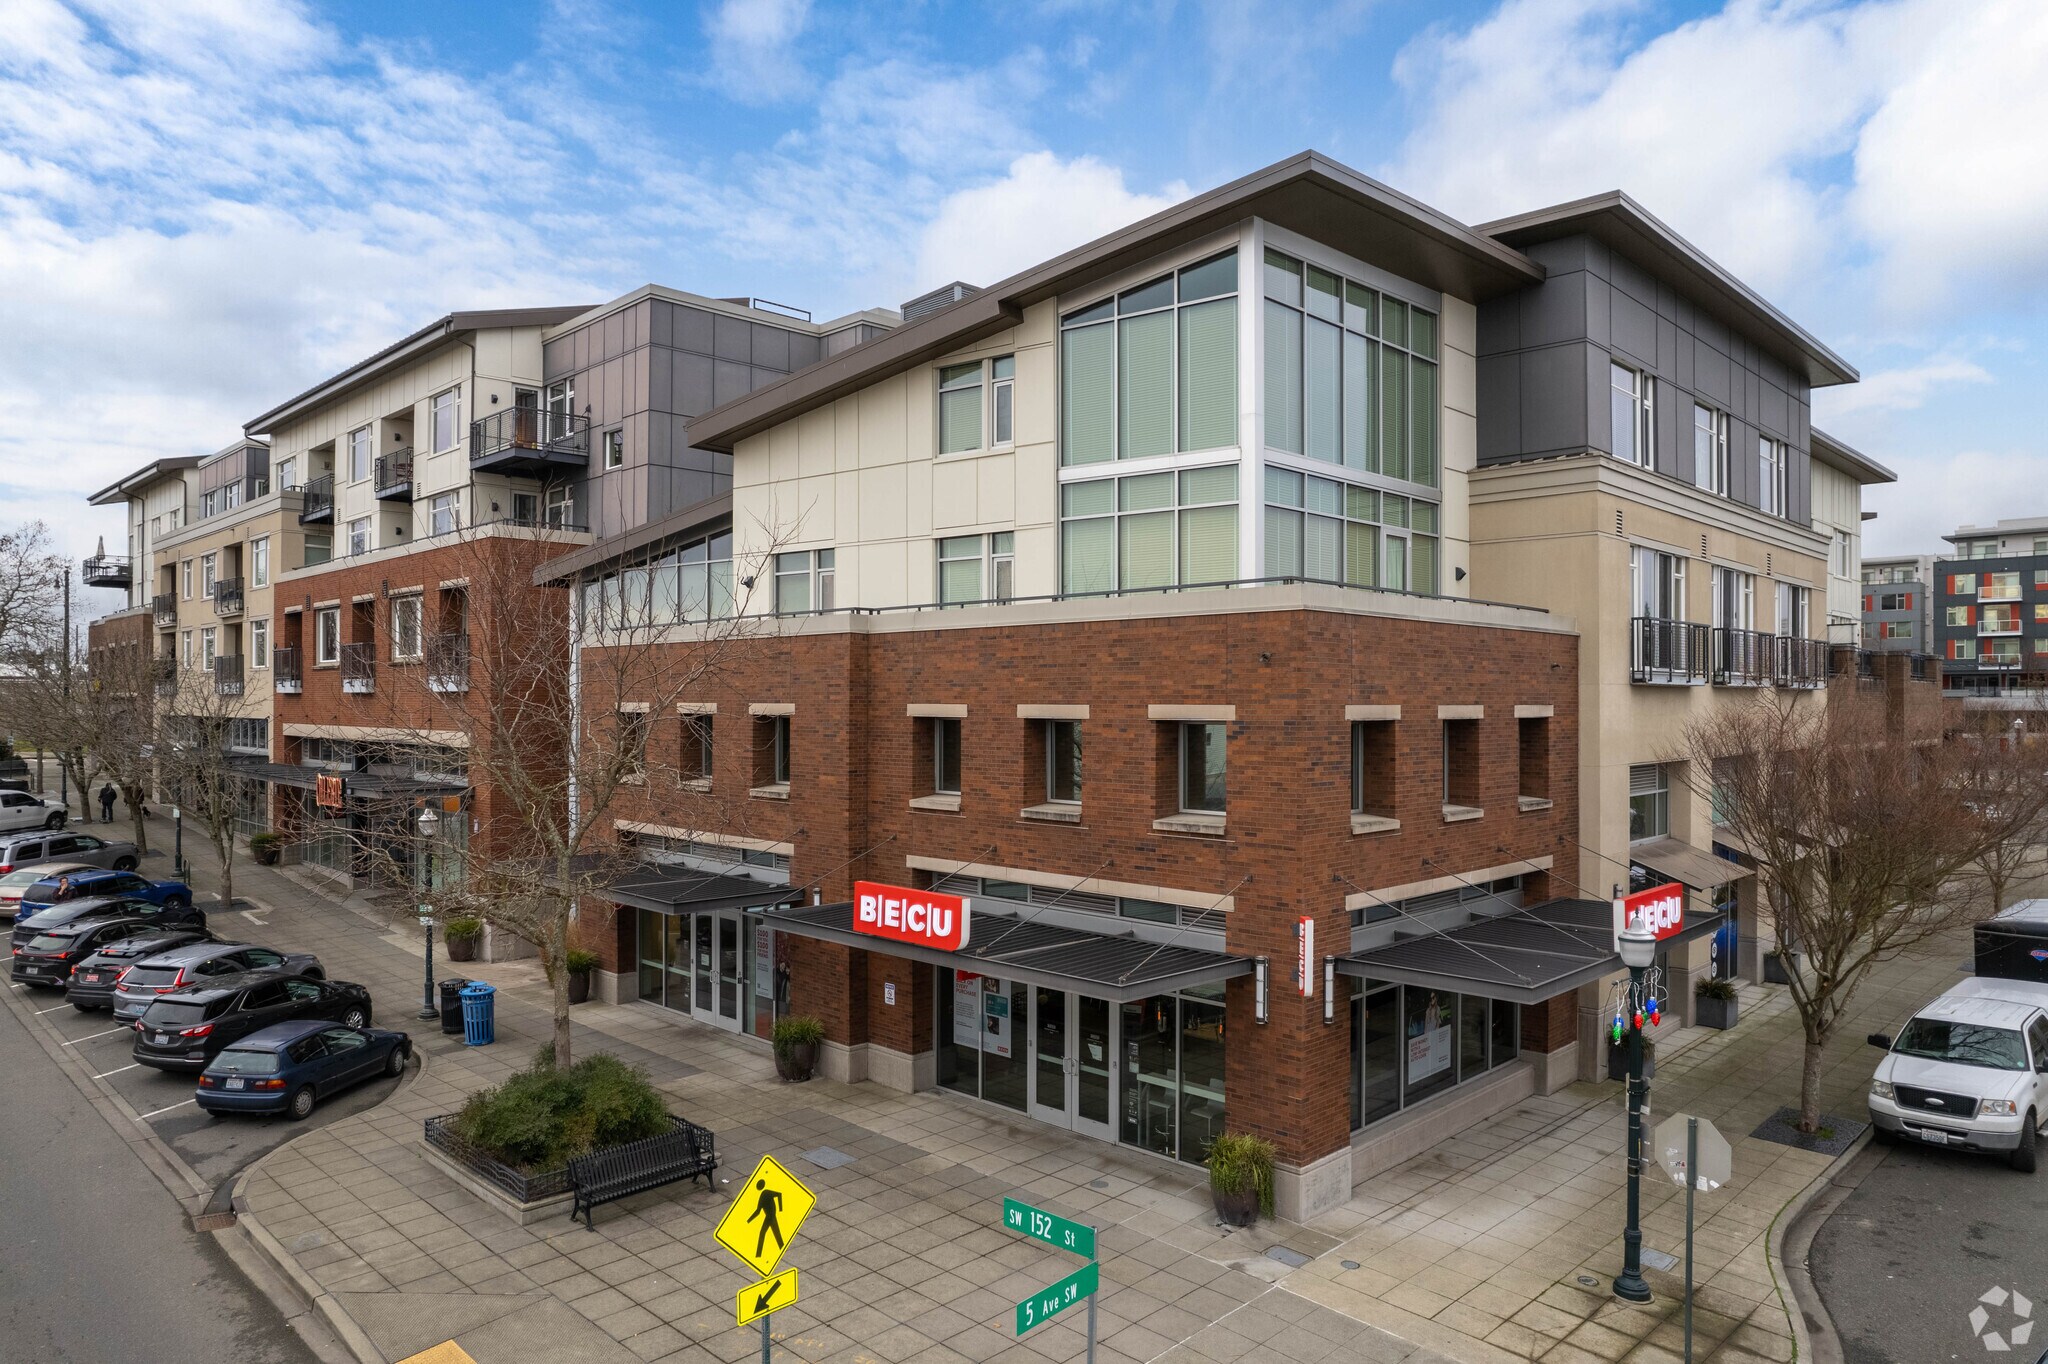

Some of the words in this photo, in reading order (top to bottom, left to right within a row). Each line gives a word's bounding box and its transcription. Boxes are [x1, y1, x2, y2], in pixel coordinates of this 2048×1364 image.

[1010, 1209, 1022, 1226] SW
[1031, 1212, 1052, 1239] 152
[1065, 1230, 1075, 1247] St
[1026, 1301, 1033, 1326] 5
[1043, 1299, 1059, 1316] Ave
[1065, 1283, 1077, 1303] SW
